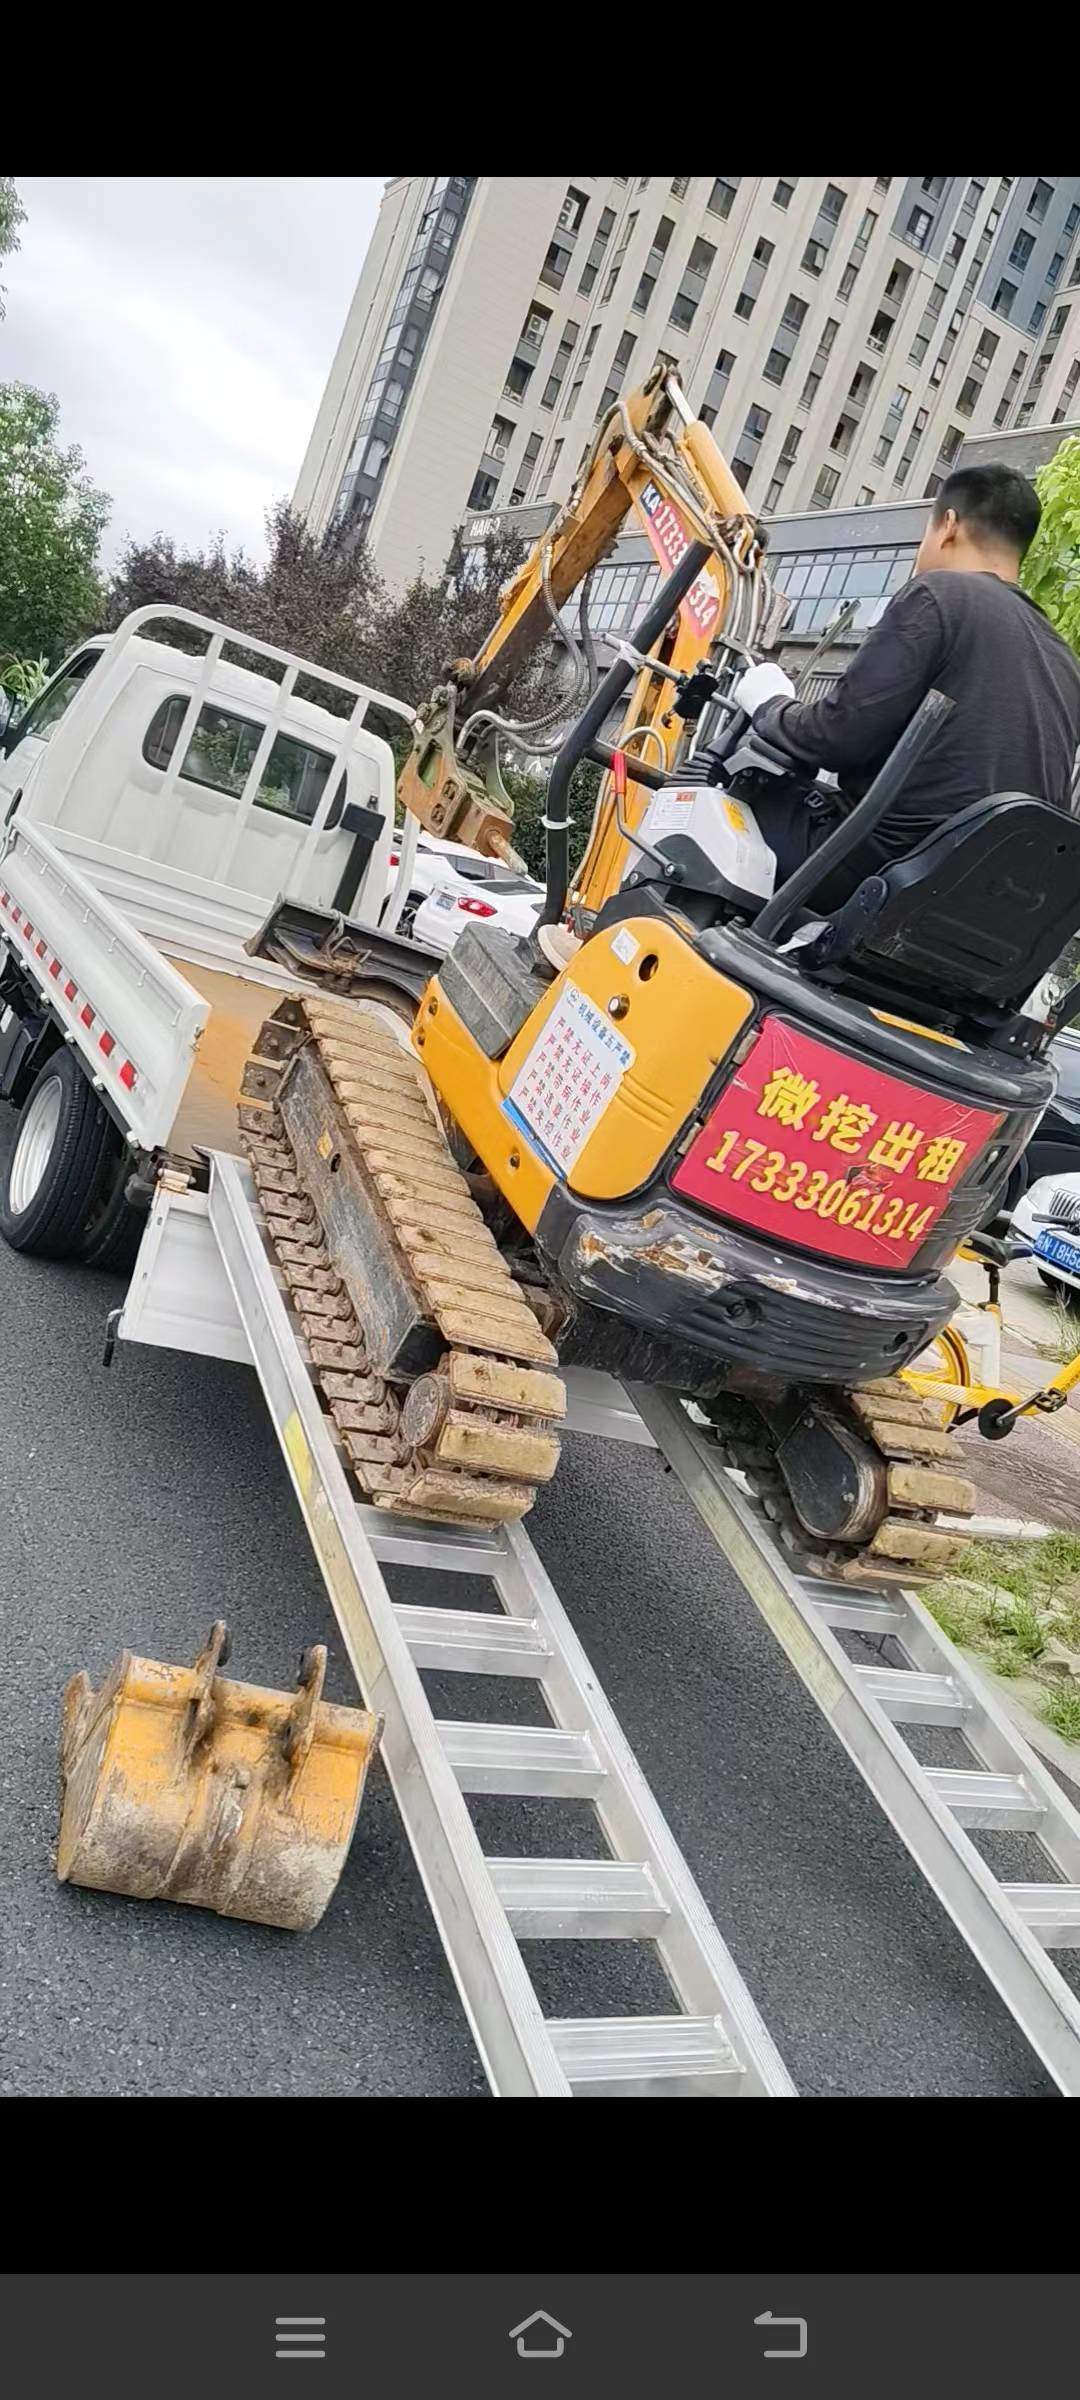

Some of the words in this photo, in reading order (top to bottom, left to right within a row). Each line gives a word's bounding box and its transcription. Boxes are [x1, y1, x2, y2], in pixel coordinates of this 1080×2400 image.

[554, 1016, 613, 1090] 严禁无证上岗
[756, 1066, 968, 1186] 微挖出租
[705, 1129, 936, 1242] 17333061314
